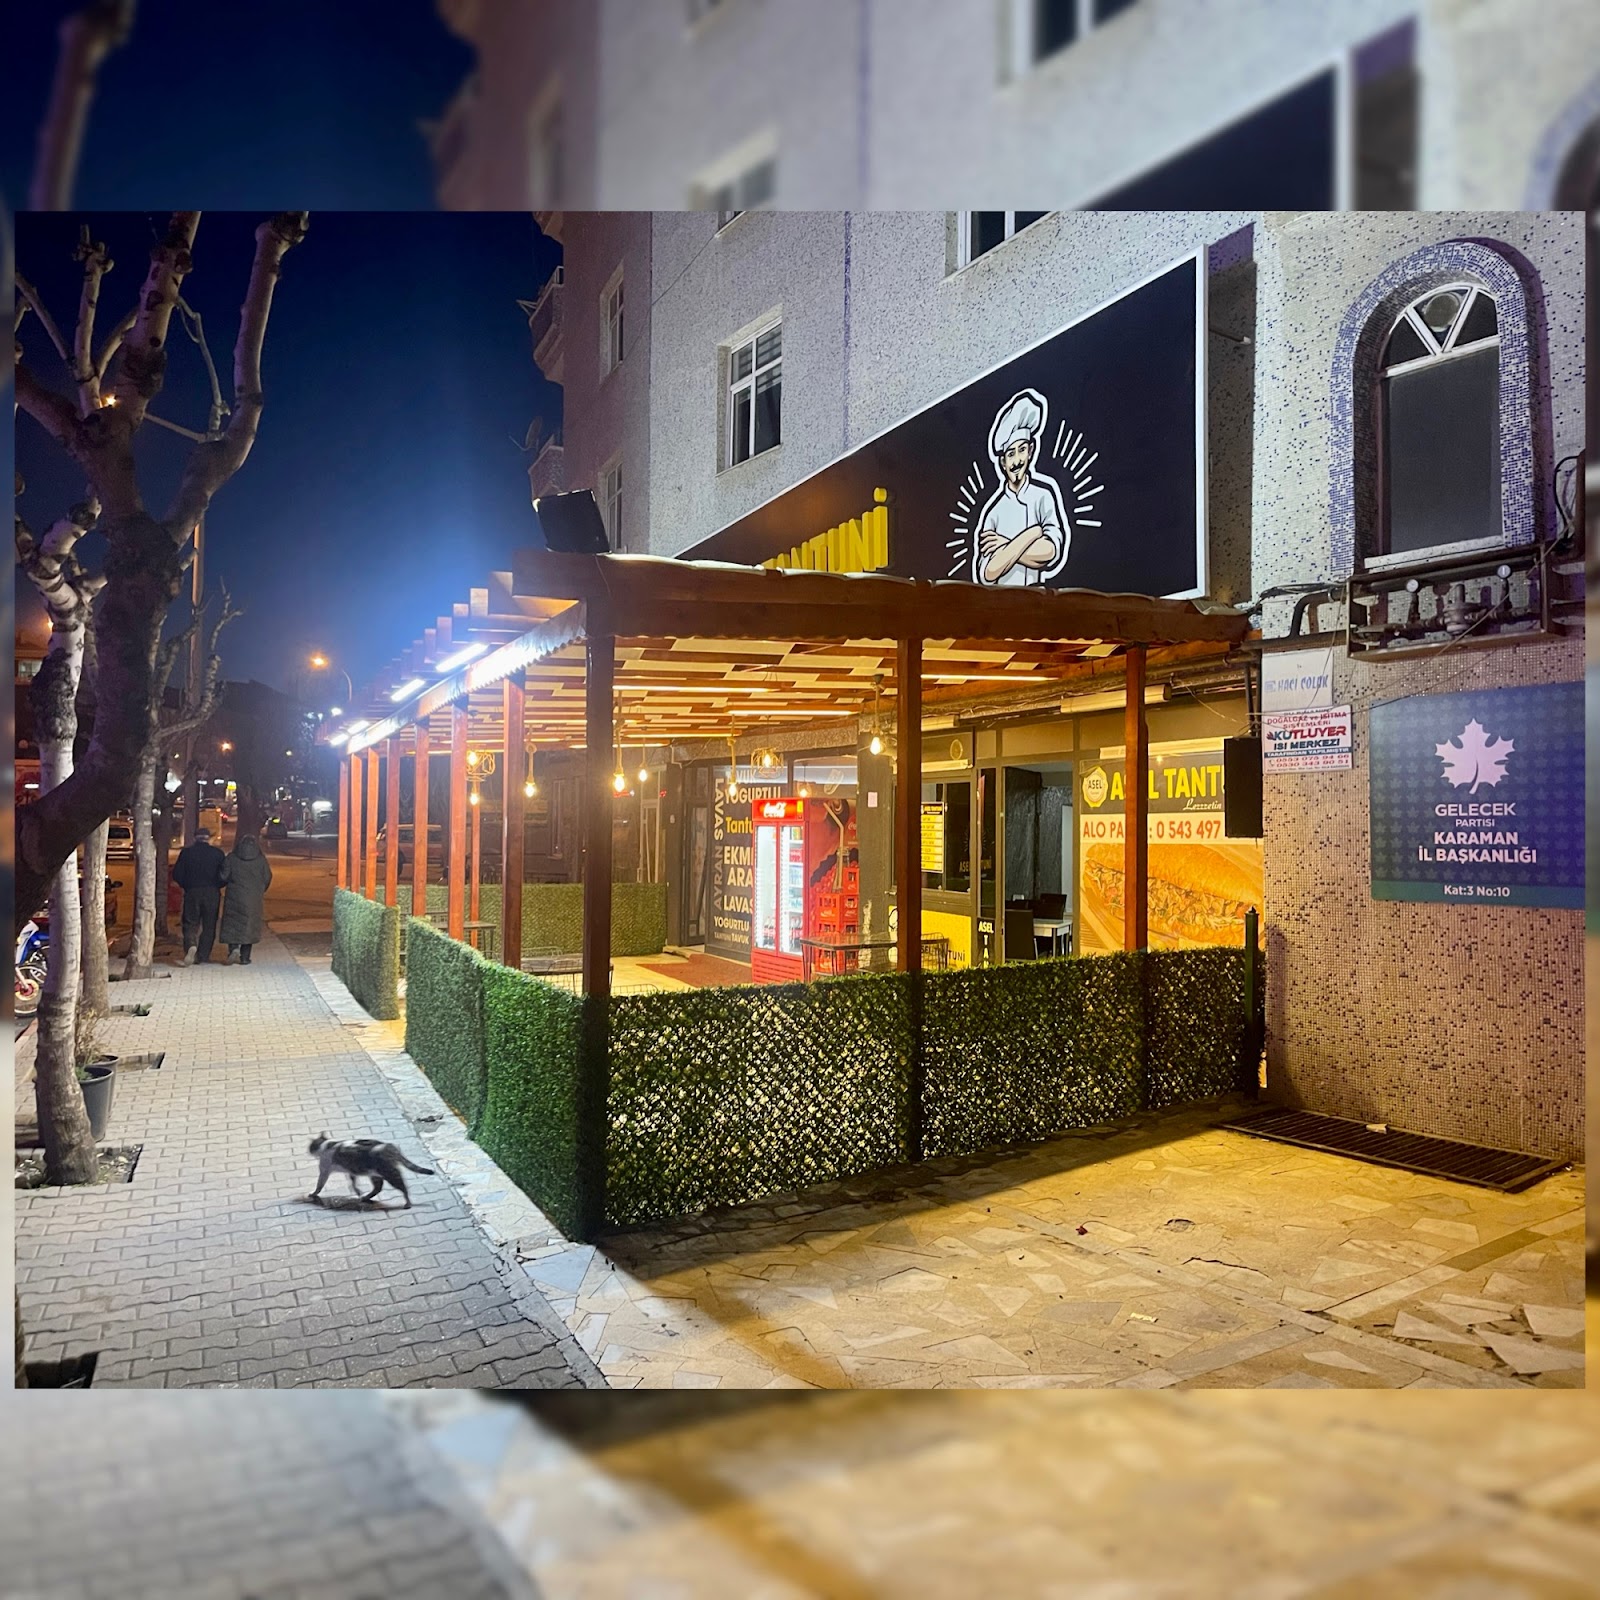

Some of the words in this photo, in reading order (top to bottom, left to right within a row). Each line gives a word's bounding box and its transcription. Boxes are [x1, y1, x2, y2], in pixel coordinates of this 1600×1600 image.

[1274, 725, 1347, 740] KUTLUYER
[1088, 780, 1102, 789] ASEL
[1435, 803, 1516, 817] GELECEK
[1083, 821, 1106, 839] ALO
[1156, 821, 1165, 839] 0
[1169, 821, 1192, 839] 543
[1196, 820, 1221, 839] 497
[1434, 832, 1518, 845] KARAMAN
[1418, 846, 1432, 861] İL
[1436, 846, 1537, 864] BAŞKANLIĞI
[713, 846, 724, 911] AYRAN
[1444, 885, 1474, 896] Kat:3
[1476, 885, 1510, 897] No:10
[978, 921, 994, 934] ASEL
